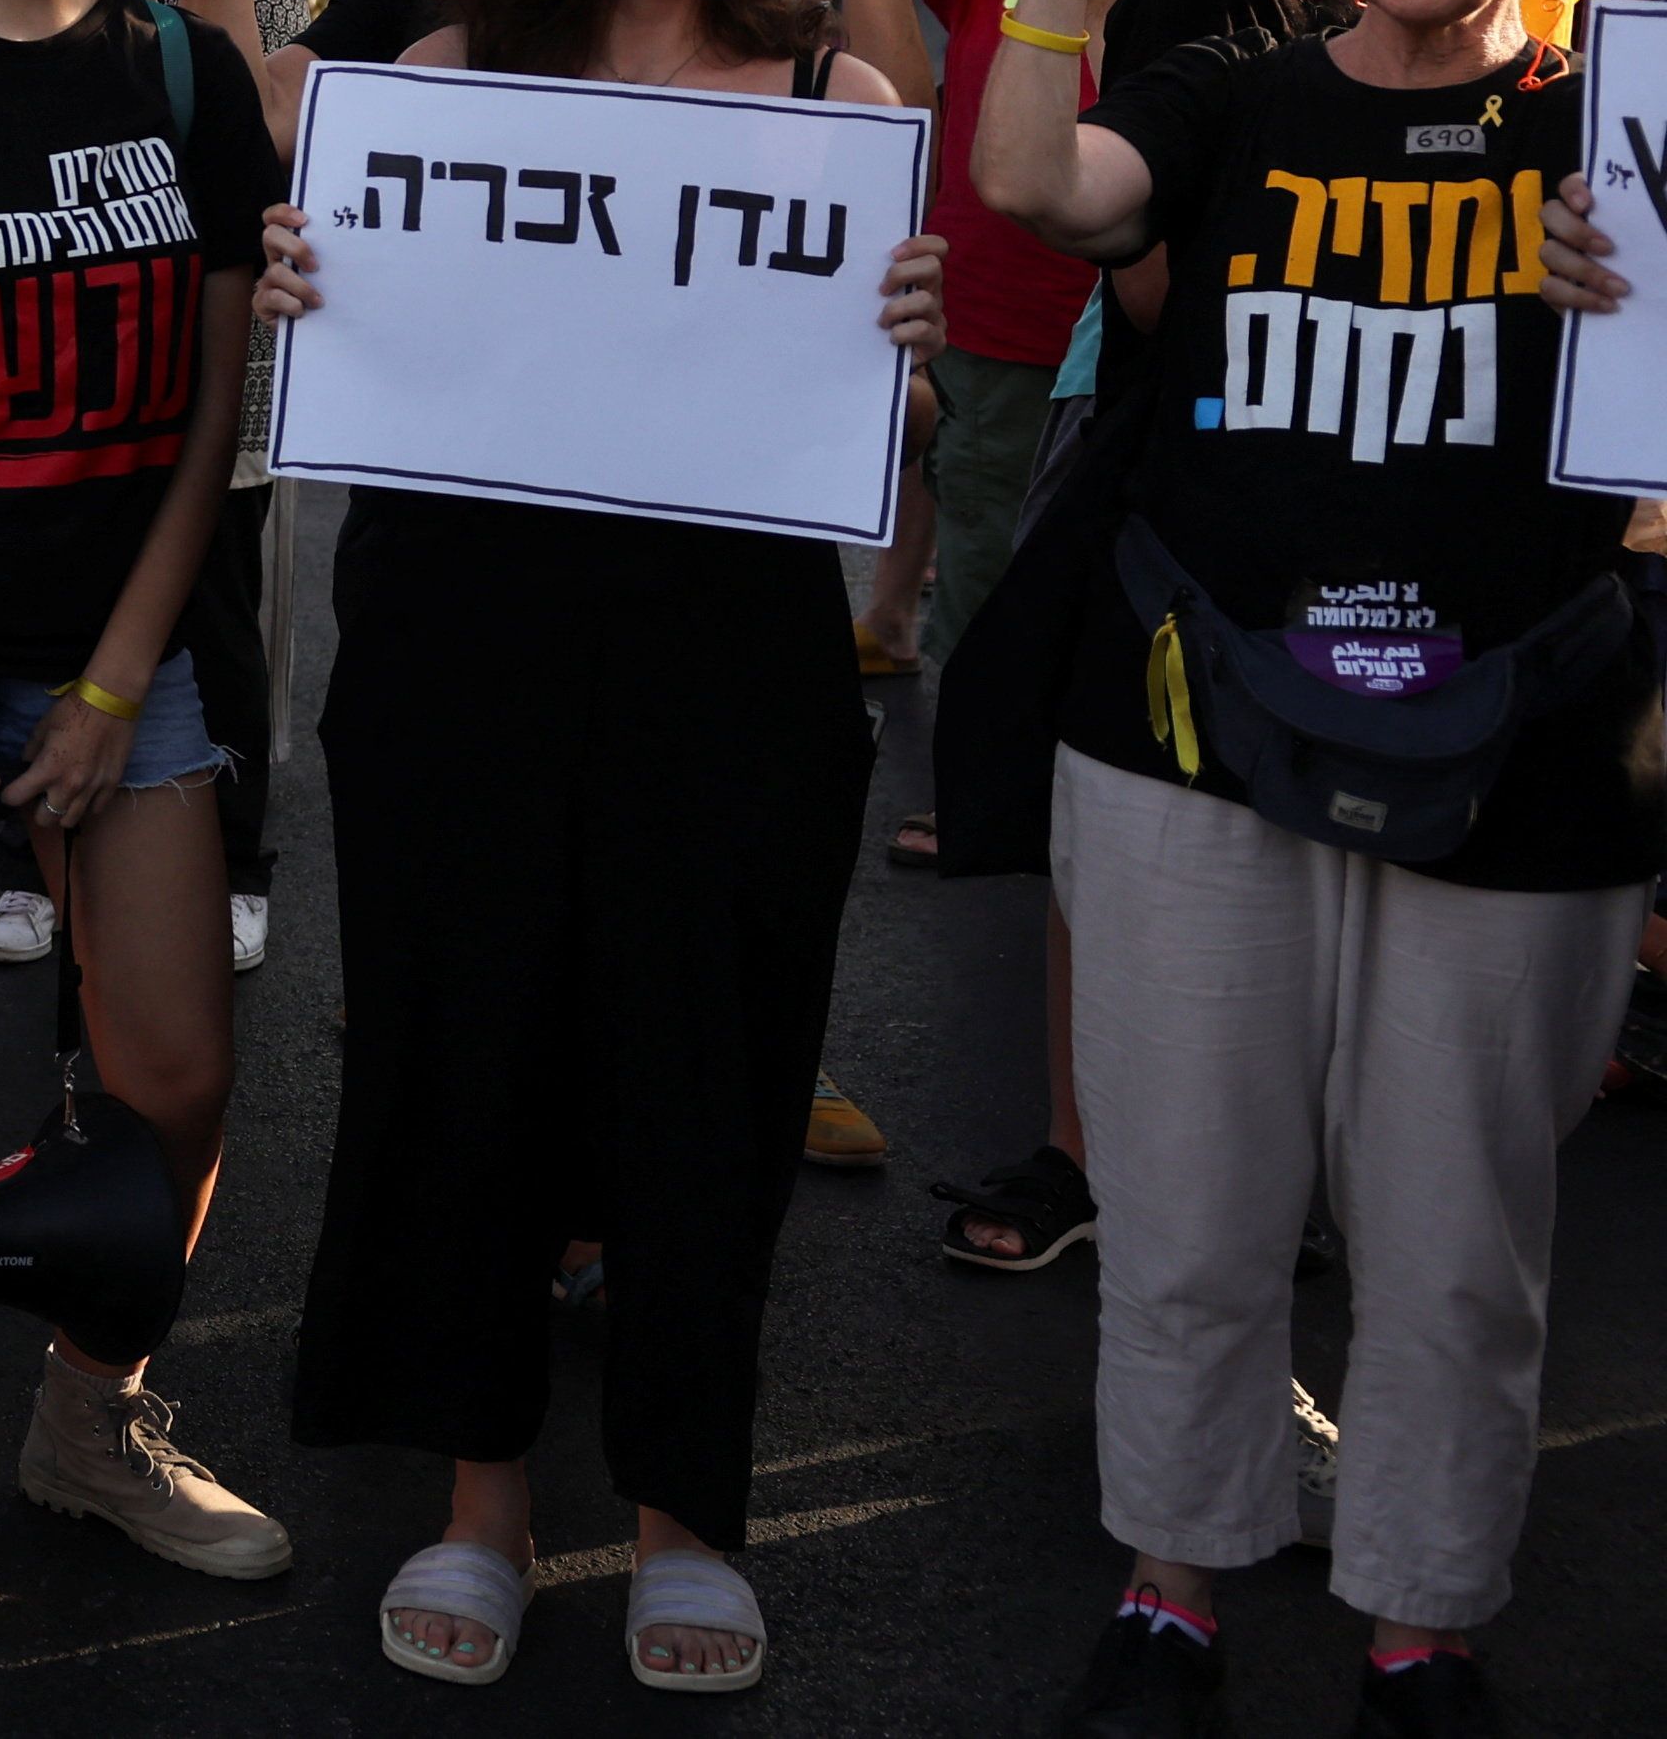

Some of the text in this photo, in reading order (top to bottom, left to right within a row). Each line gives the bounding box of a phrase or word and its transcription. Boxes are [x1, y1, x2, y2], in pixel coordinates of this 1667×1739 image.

[48, 136, 177, 208] מחזירים
[1416, 129, 1476, 148] 690
[104, 186, 197, 250] אותם
[363, 151, 622, 256] זכריה
[674, 184, 847, 287] עדן
[1307, 605, 1437, 629] לא למלחמה
